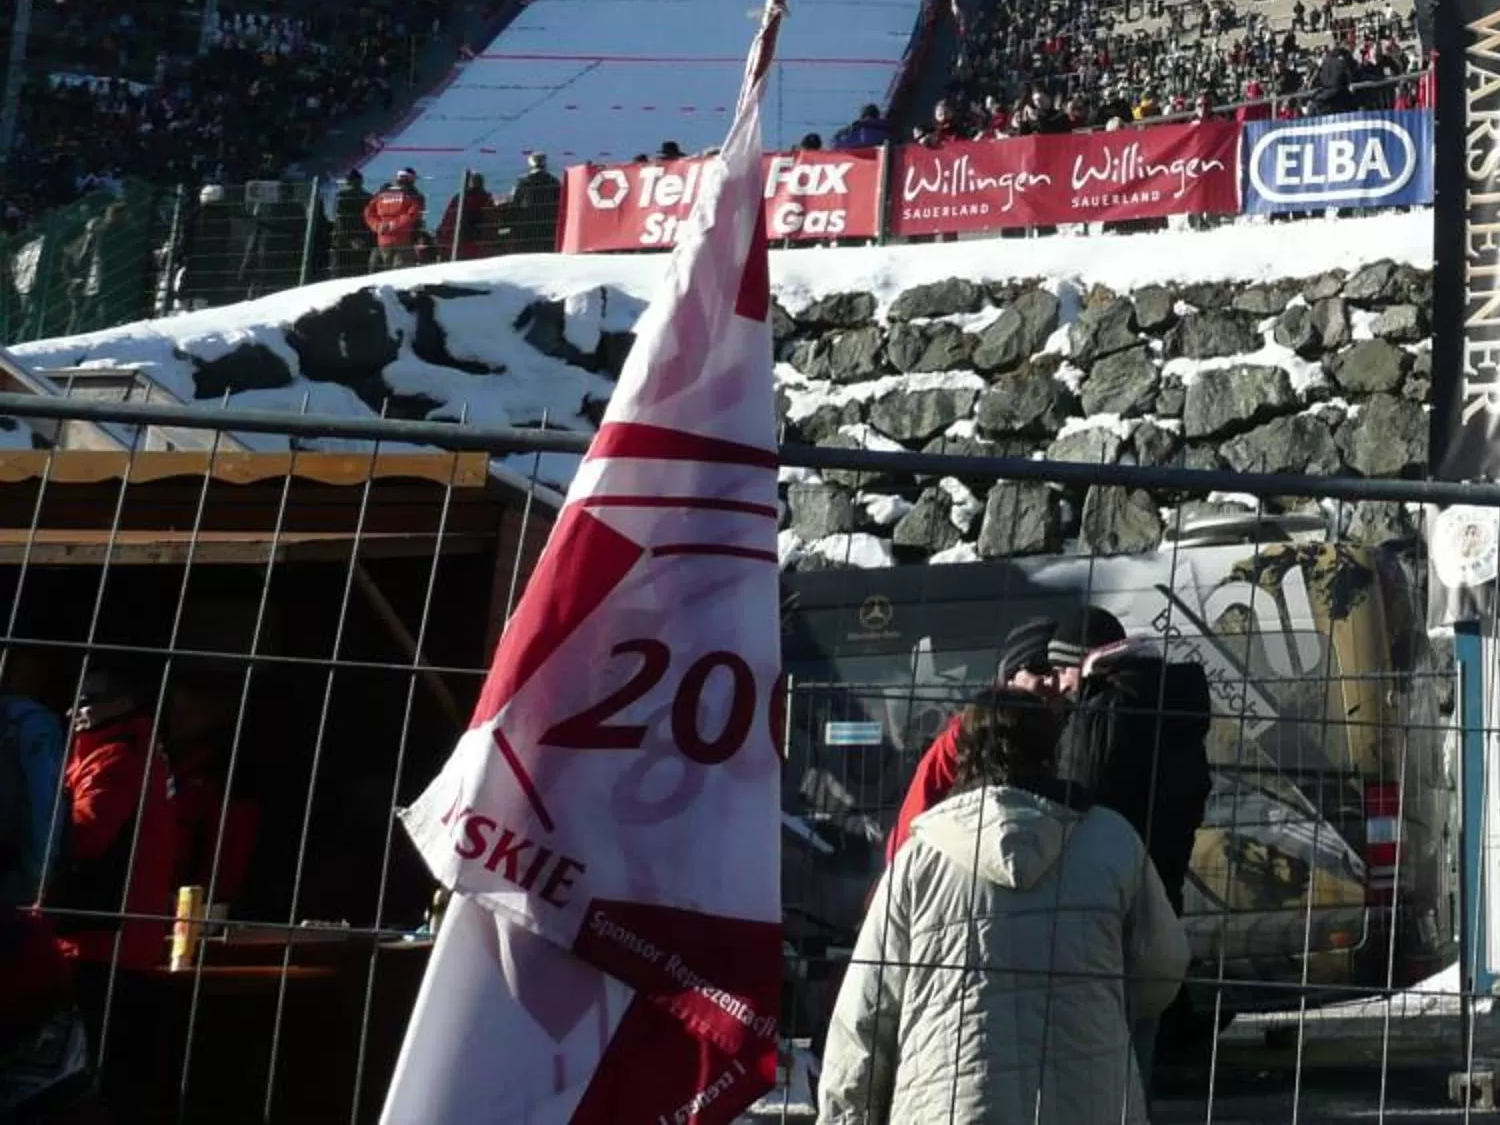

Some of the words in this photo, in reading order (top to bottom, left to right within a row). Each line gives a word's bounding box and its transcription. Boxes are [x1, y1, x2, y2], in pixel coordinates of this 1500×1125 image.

[903, 153, 1051, 211] Willingen
[1071, 142, 1226, 197] Willingen
[1275, 137, 1392, 187] ELBA
[772, 202, 847, 234] Gas
[902, 203, 990, 220] SAUERLAND
[1071, 190, 1161, 209] SAUERLAND
[589, 910, 666, 964] Sponsor
